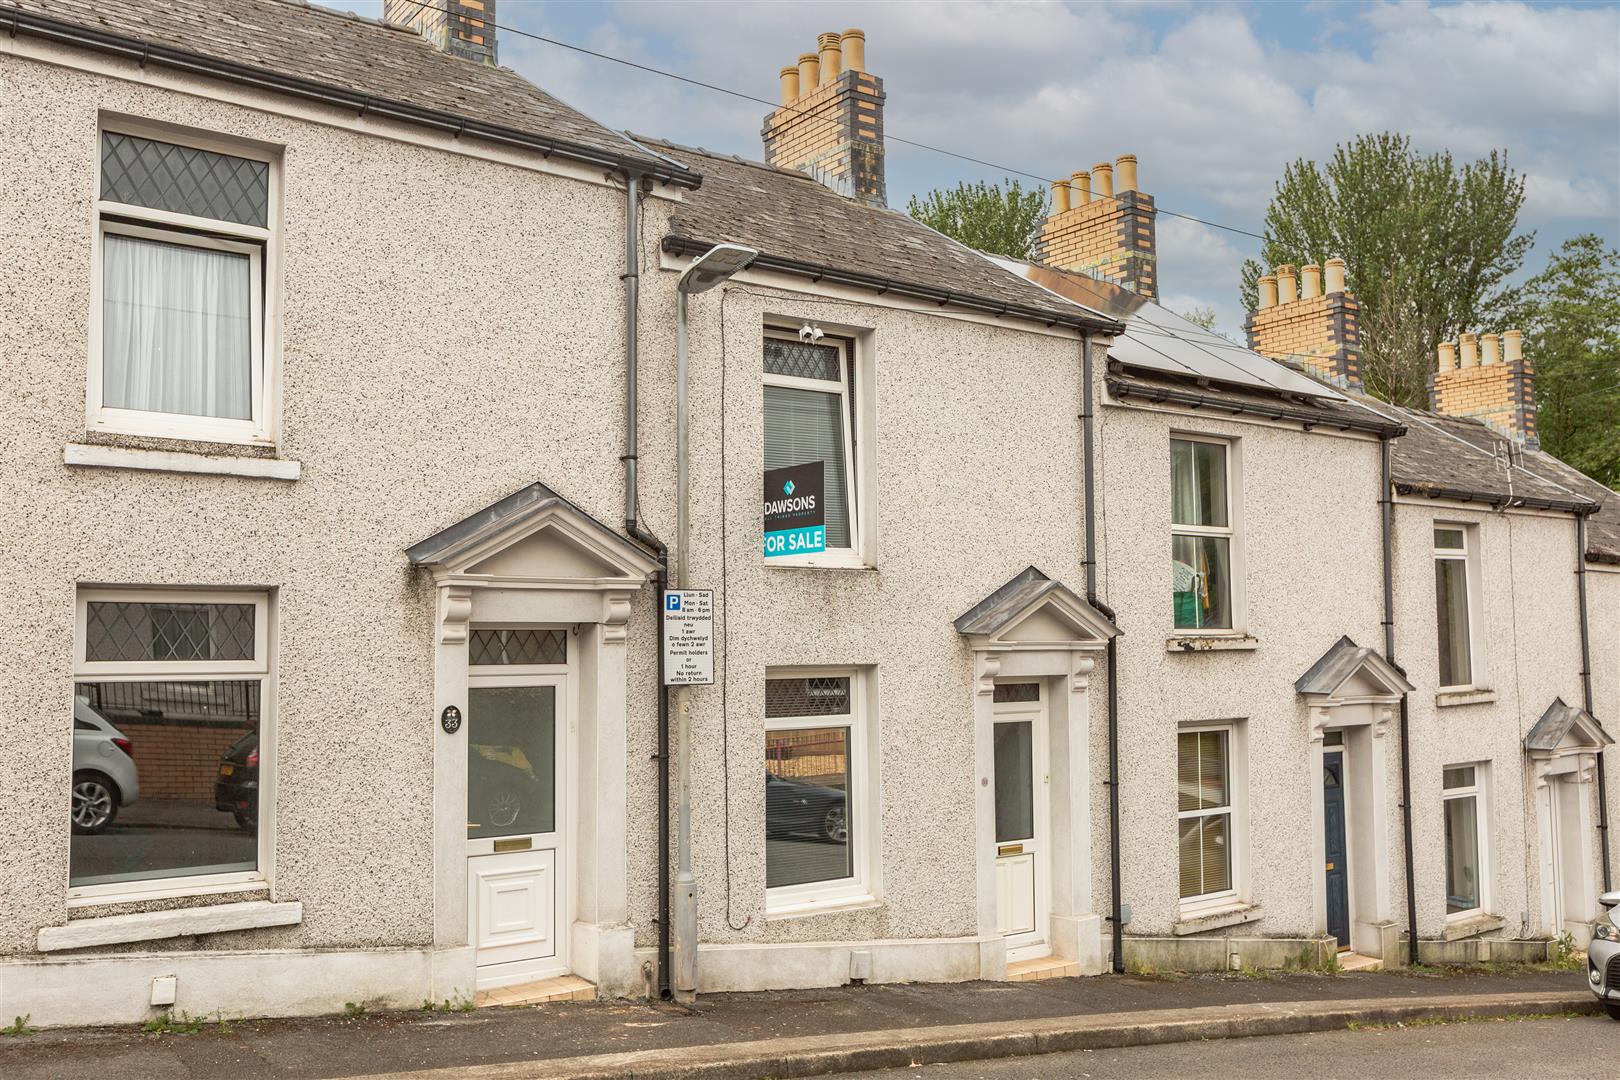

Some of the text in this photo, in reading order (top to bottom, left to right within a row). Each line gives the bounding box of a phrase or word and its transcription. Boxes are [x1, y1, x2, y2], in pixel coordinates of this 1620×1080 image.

[764, 495, 816, 515] DAWSONS
[764, 531, 822, 552] OR SALE
[670, 596, 679, 609] P
[445, 719, 458, 729] 33
